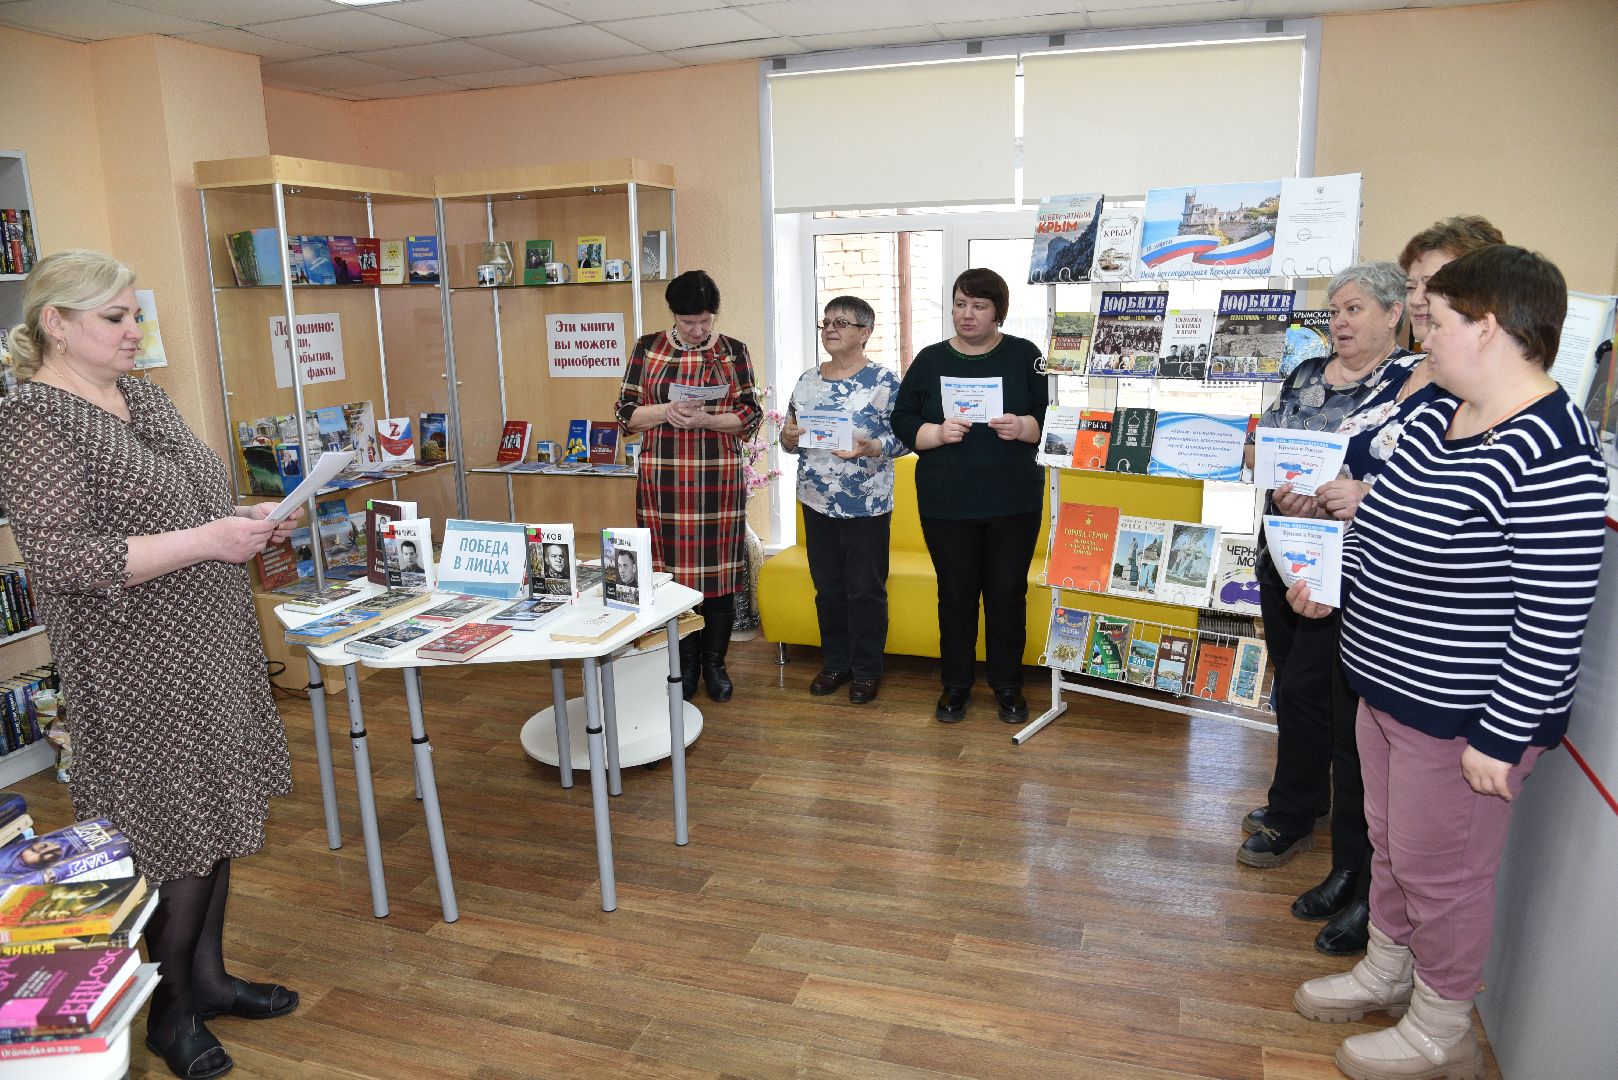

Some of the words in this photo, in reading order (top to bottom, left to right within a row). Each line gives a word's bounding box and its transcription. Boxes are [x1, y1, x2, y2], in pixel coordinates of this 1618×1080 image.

[1036, 220, 1078, 234] КРЫМ
[1103, 228, 1132, 239] КРЫМ
[1103, 296, 1128, 313] 100
[1127, 296, 1166, 309] БИТВ
[1221, 295, 1248, 311] 100
[1248, 294, 1291, 309] БИТВ
[274, 321, 335, 337] Лоошино:
[555, 320, 576, 333] Эти
[580, 322, 615, 332] книги
[1303, 318, 1330, 328] ВОЙНА
[284, 338, 311, 350] лди,
[554, 340, 571, 350] вы
[574, 339, 618, 350] можете
[554, 354, 620, 370] приобрести
[307, 367, 337, 381] факты
[1081, 420, 1109, 430] КРЫМ
[459, 537, 509, 559] ПОБЕДА
[453, 556, 462, 570] В
[464, 557, 510, 577] ЛИЦАХ
[1132, 657, 1148, 668] ЯЛТА
[2, 943, 55, 956] ЖИЗНЬ
